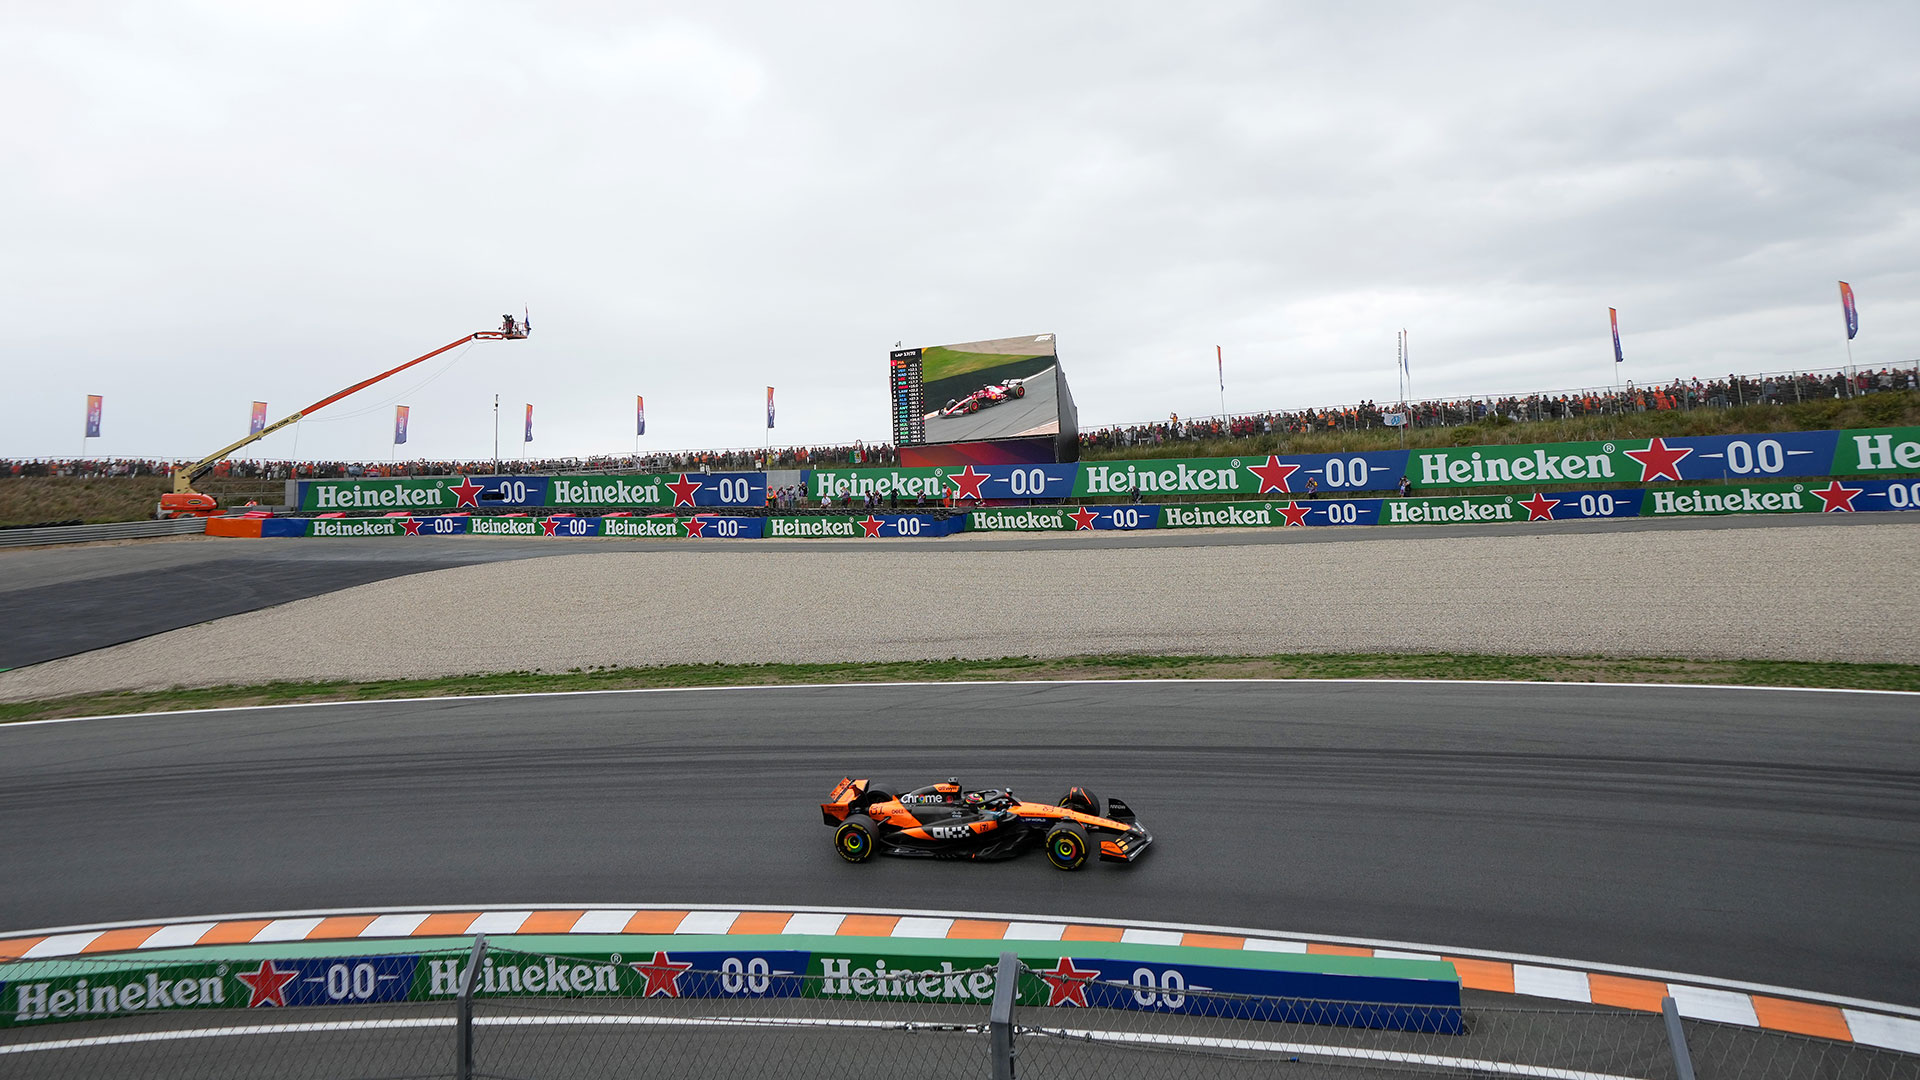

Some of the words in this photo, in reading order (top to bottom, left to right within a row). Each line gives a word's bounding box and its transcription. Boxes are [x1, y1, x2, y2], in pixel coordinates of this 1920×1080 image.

[1420, 450, 1615, 484] Heineken
[1727, 440, 1784, 473] 0.0
[1011, 469, 1045, 494] 0.0
[1086, 464, 1239, 492] Heineken
[1326, 458, 1368, 487] 0.0
[317, 485, 442, 507] Heineken
[500, 481, 525, 503] 0.0
[554, 482, 660, 503] Heineken
[719, 478, 748, 503] 0.0
[1653, 489, 1803, 513] Heineken
[973, 511, 1063, 529] Heineken
[1113, 509, 1138, 527] 0.0
[1165, 506, 1271, 526] Heineken
[1328, 504, 1356, 523] 0.0
[1389, 501, 1512, 522] Heineken
[1580, 494, 1614, 516] 0.0
[313, 520, 395, 536] Heineken
[434, 518, 453, 533] 0.0
[472, 518, 536, 534] Heineken
[570, 519, 586, 535] 0.0
[605, 520, 677, 536] Heineken
[718, 520, 737, 536] 0.0
[771, 519, 854, 536] Heineken
[898, 518, 919, 535] 0.0
[901, 794, 942, 804] Chrome
[933, 826, 970, 838] OKX
[721, 958, 769, 992] 0.0
[820, 958, 1022, 1000] Heineke
[1133, 968, 1186, 1008] 0.0
[15, 972, 224, 1021] Heineken
[327, 963, 375, 1000] 0.0
